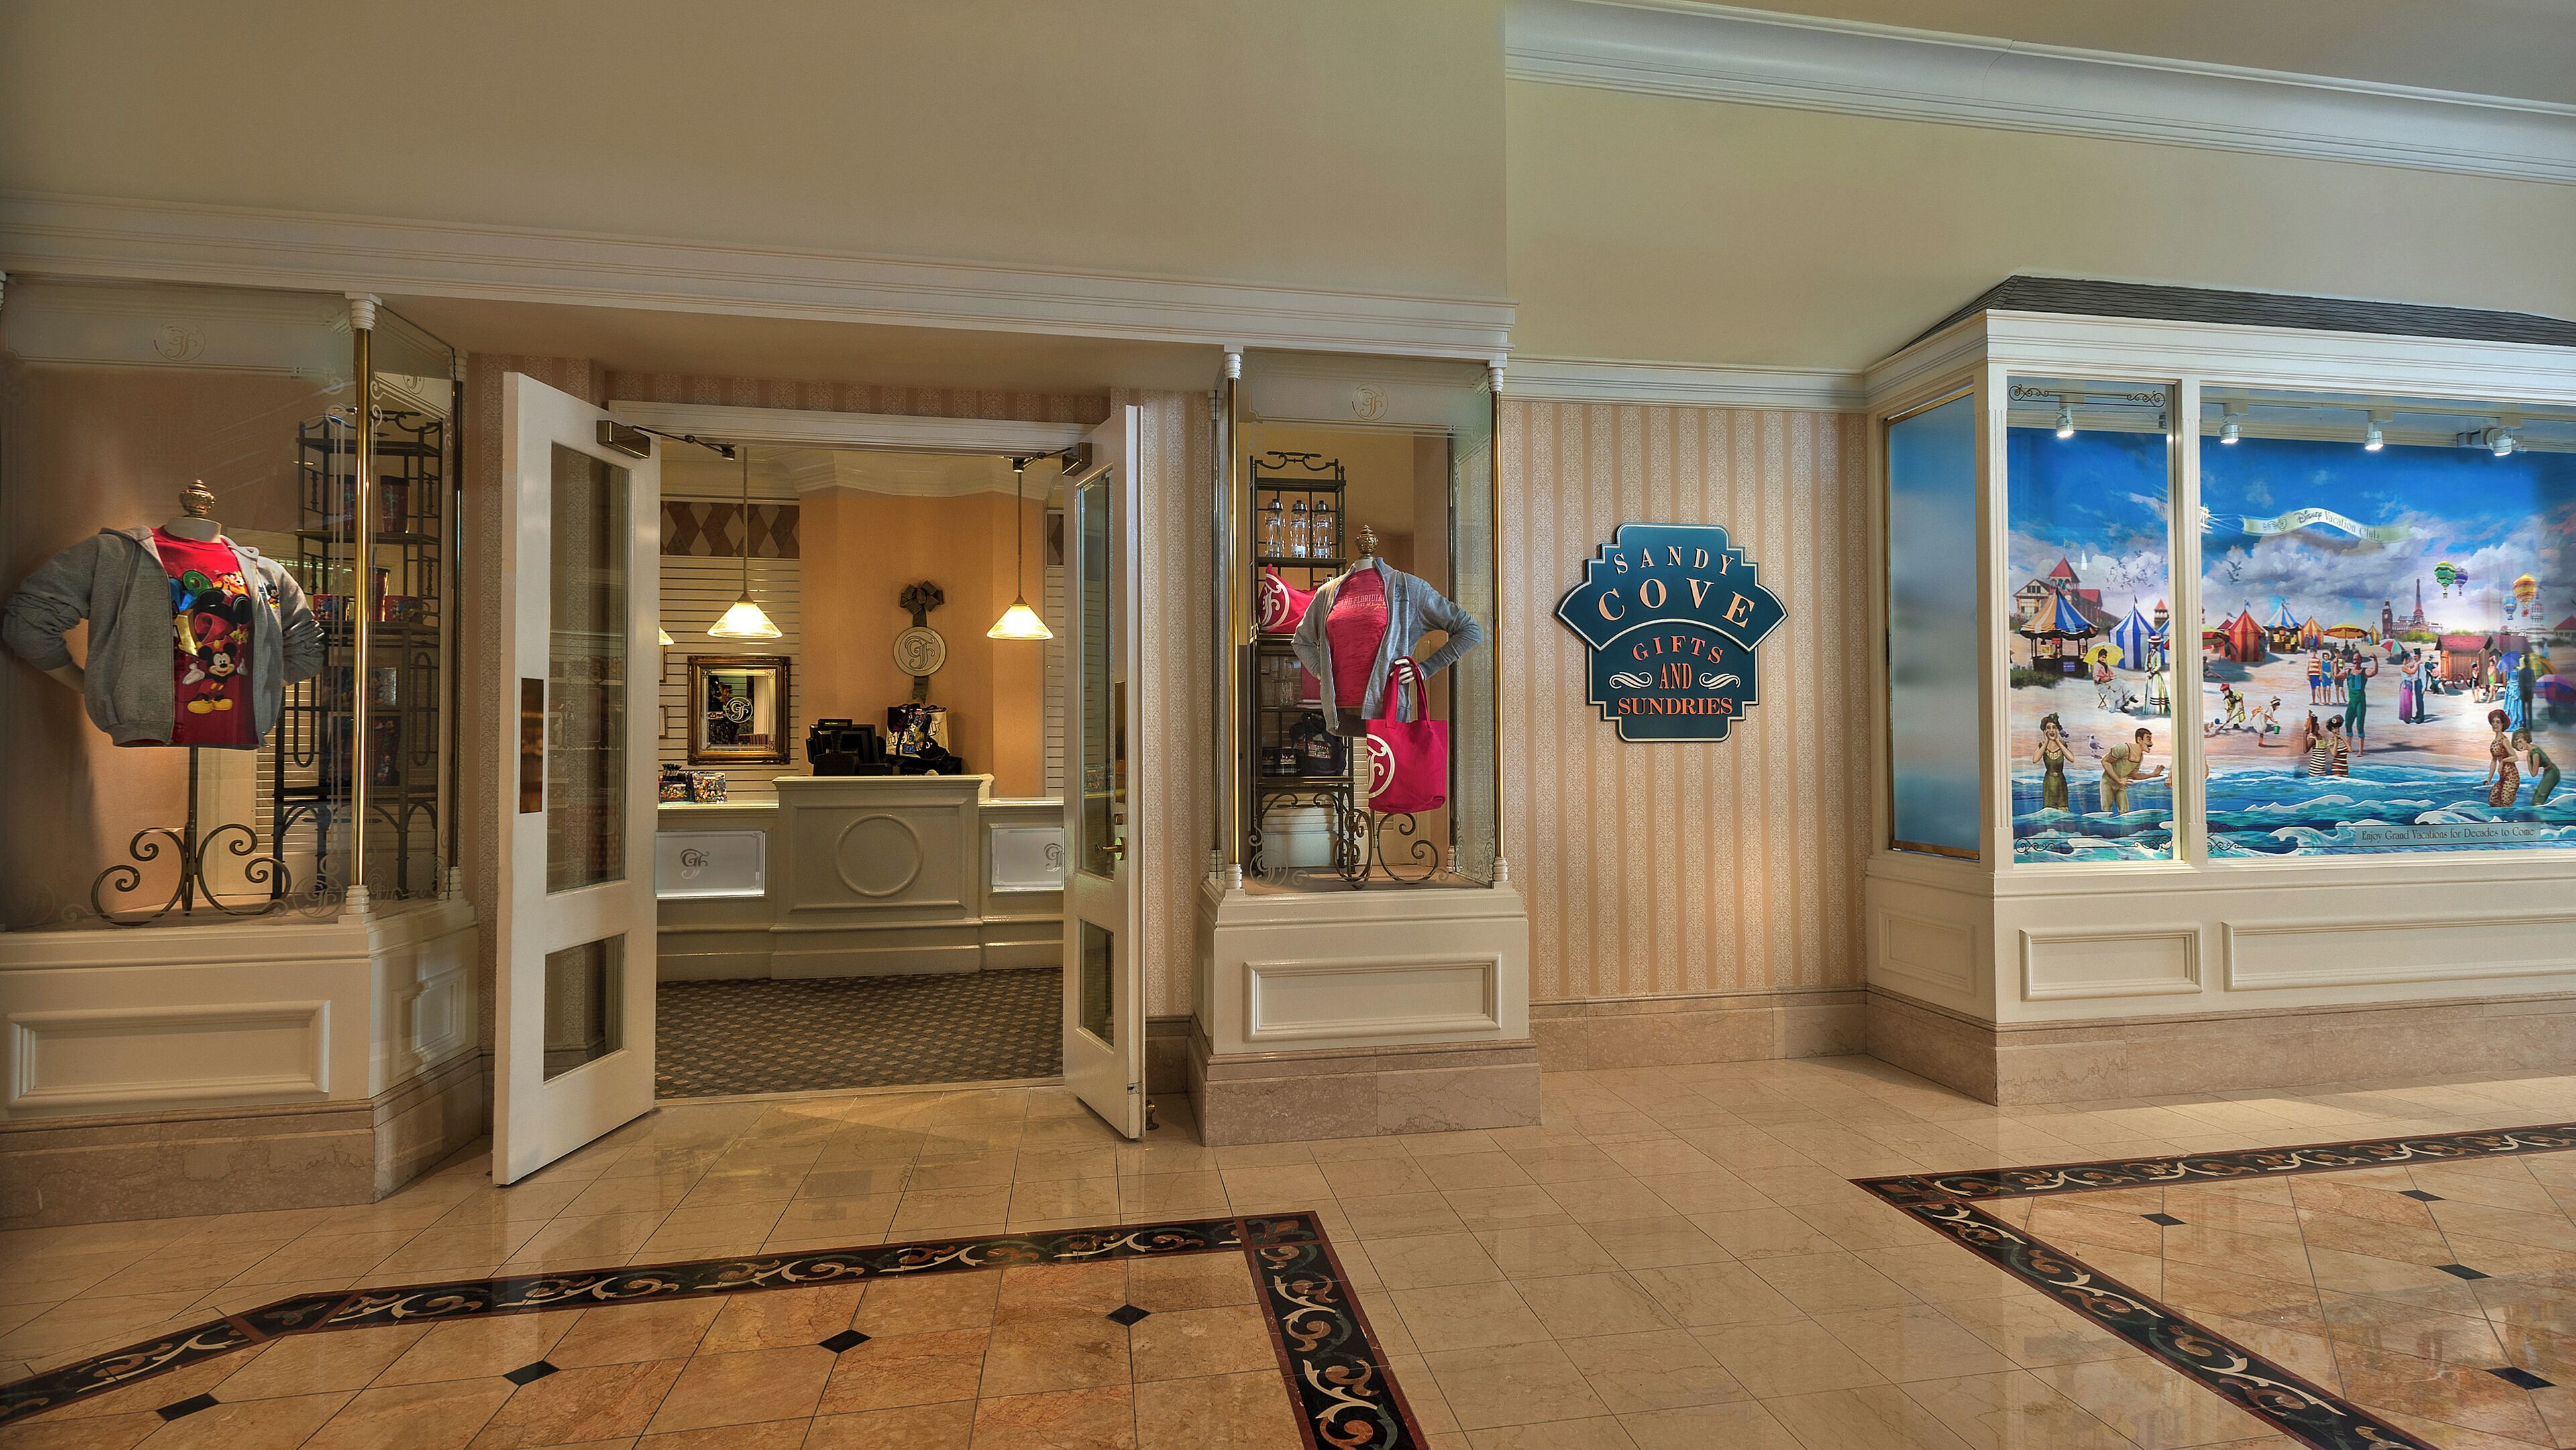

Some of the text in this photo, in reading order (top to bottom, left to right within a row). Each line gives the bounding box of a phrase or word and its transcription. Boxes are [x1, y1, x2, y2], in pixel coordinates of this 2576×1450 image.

[2324, 511, 2356, 533] Vacation
[2359, 526, 2379, 541] Club
[1613, 546, 1735, 575] SANDY
[1598, 577, 1756, 628] COVE
[1632, 635, 1723, 664] GIFTS
[1658, 663, 1693, 689] AND
[1617, 697, 1733, 716] SUNDRIES
[2362, 826, 2534, 843] Enjoy Grand Vacations for Decades to Come
